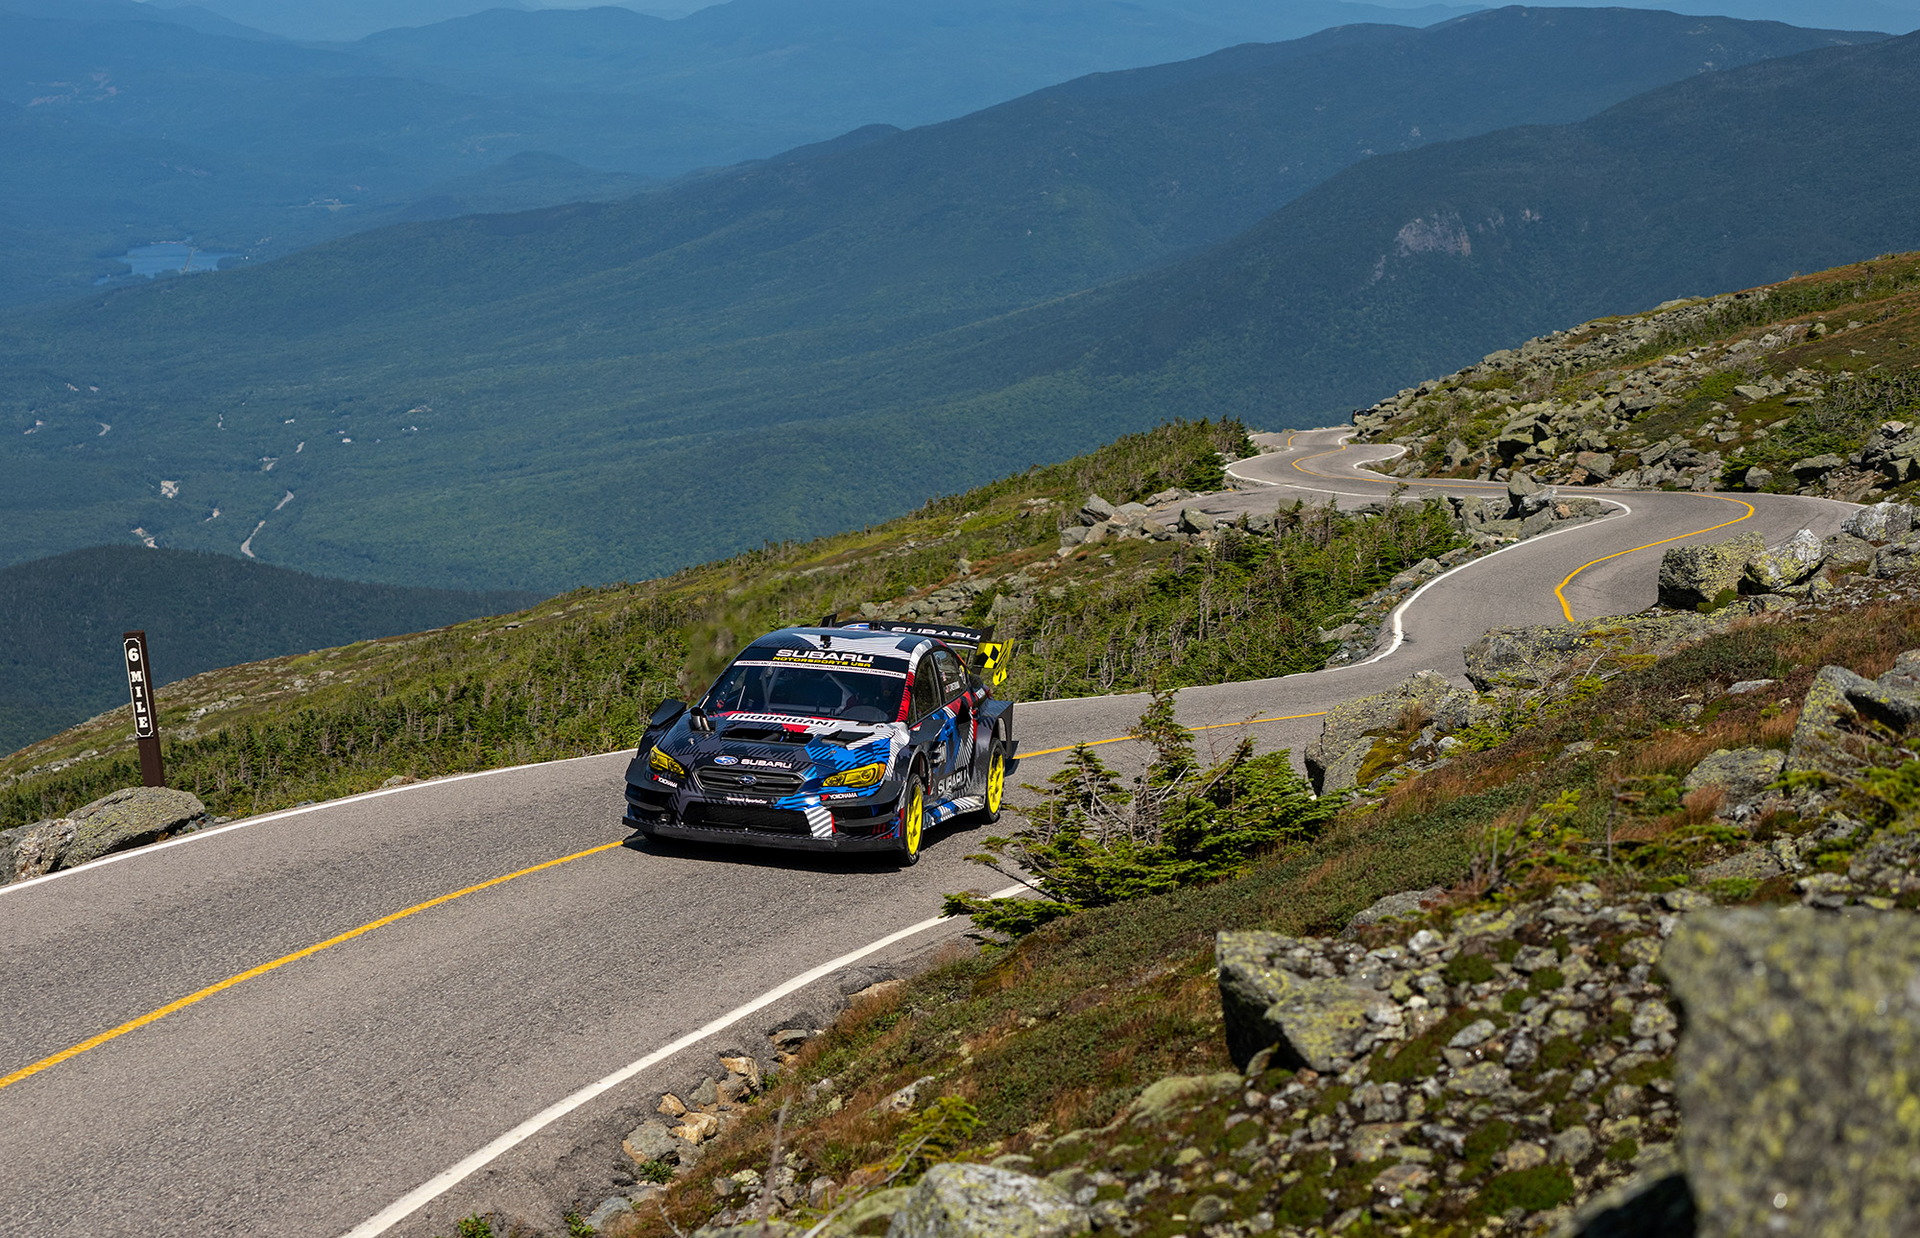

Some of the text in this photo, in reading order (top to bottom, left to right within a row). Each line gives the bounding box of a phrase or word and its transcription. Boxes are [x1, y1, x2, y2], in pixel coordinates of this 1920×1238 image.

[891, 626, 981, 640] SUBARU
[772, 656, 849, 666] MOTORSPORTS
[776, 648, 875, 664] SUBARU
[128, 647, 148, 728] 6 MILE
[740, 758, 792, 769] SUBARU
[828, 792, 858, 800] YOKOHAMA
